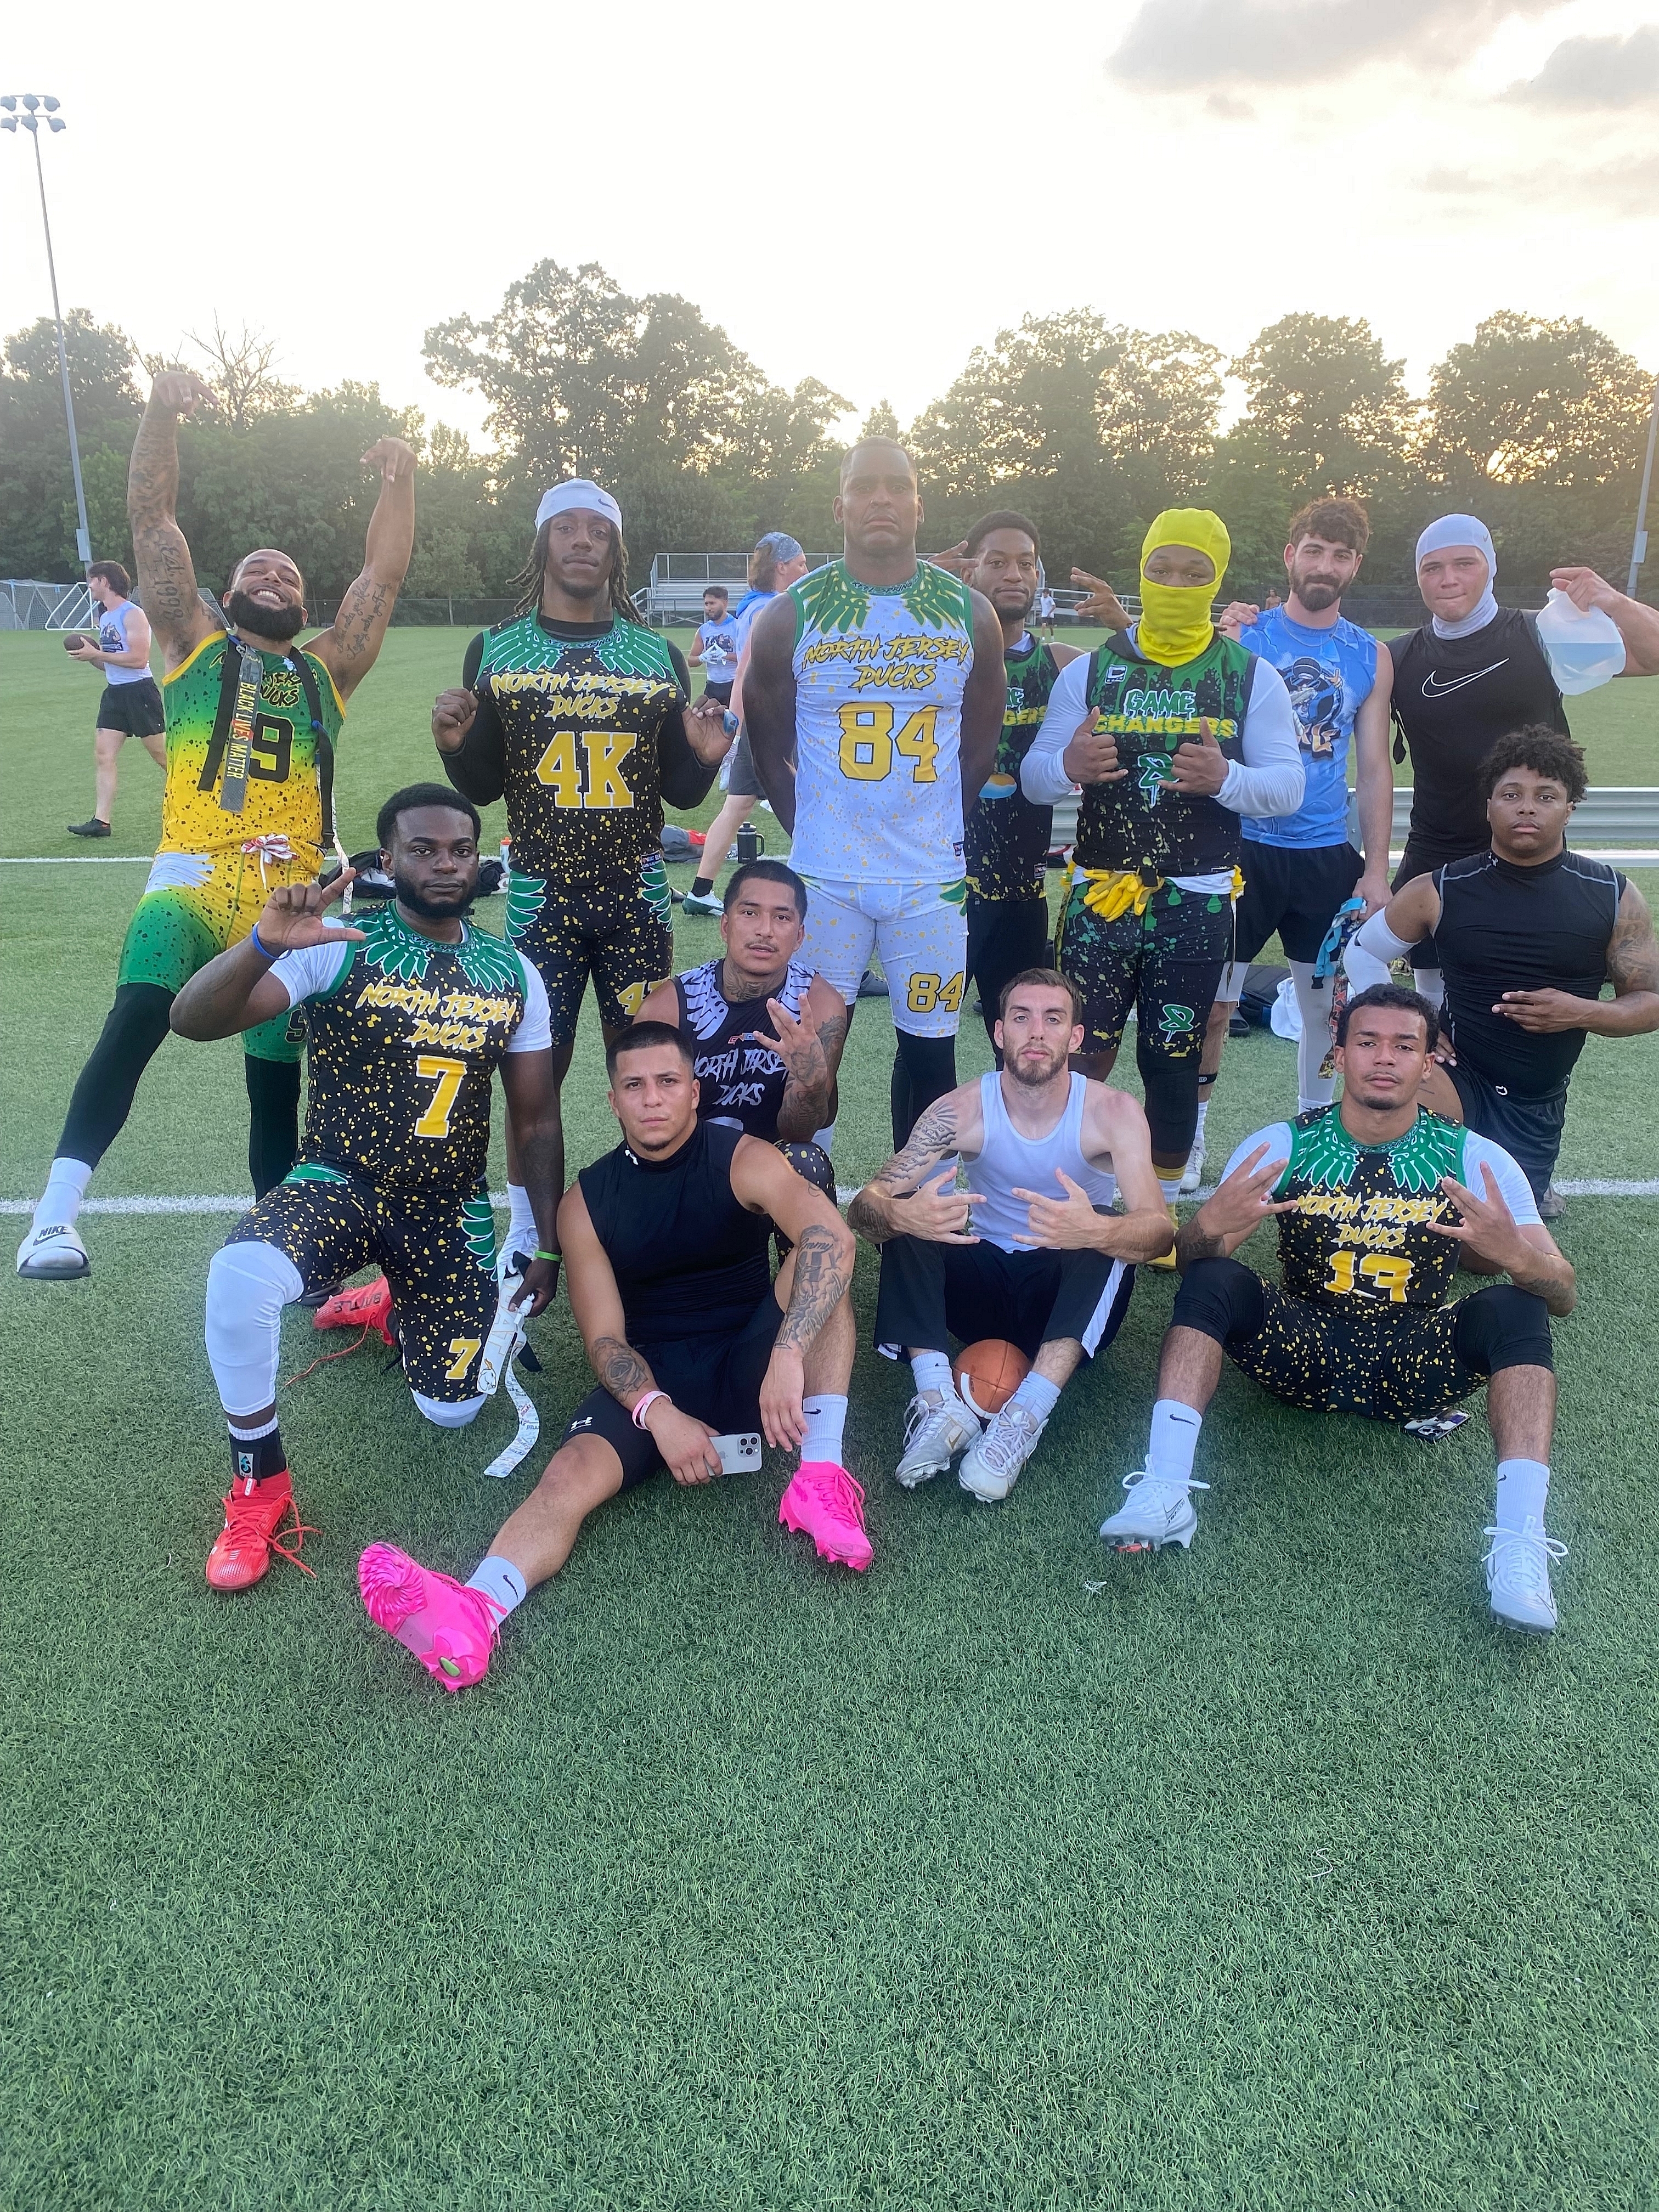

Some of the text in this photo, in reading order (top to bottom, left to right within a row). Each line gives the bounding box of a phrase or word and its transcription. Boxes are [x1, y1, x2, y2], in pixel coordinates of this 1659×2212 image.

[802, 632, 970, 672] NORTH JERSEY
[259, 684, 300, 708] UCKS
[490, 672, 670, 701] NORTH JERSEY
[848, 662, 938, 693] DUCKS
[236, 682, 257, 713] BLACK
[544, 692, 620, 721] DUCKS
[1123, 689, 1197, 721] GAME
[232, 713, 253, 741] LIVES
[837, 702, 945, 783] 84
[226, 741, 247, 780] MATTER
[248, 711, 296, 785] 9
[535, 731, 637, 809] 4K
[355, 979, 517, 1029] NORTH JERSEY
[616, 976, 670, 1016] 4
[907, 971, 964, 1013] 84
[402, 1018, 488, 1052] DUCKS
[414, 1054, 467, 1139] 7
[1293, 1190, 1450, 1227] NORTH JERSEY
[38, 1226, 69, 1238] NIKE
[1330, 1222, 1407, 1250] DUCKS
[445, 1338, 482, 1379] 7
